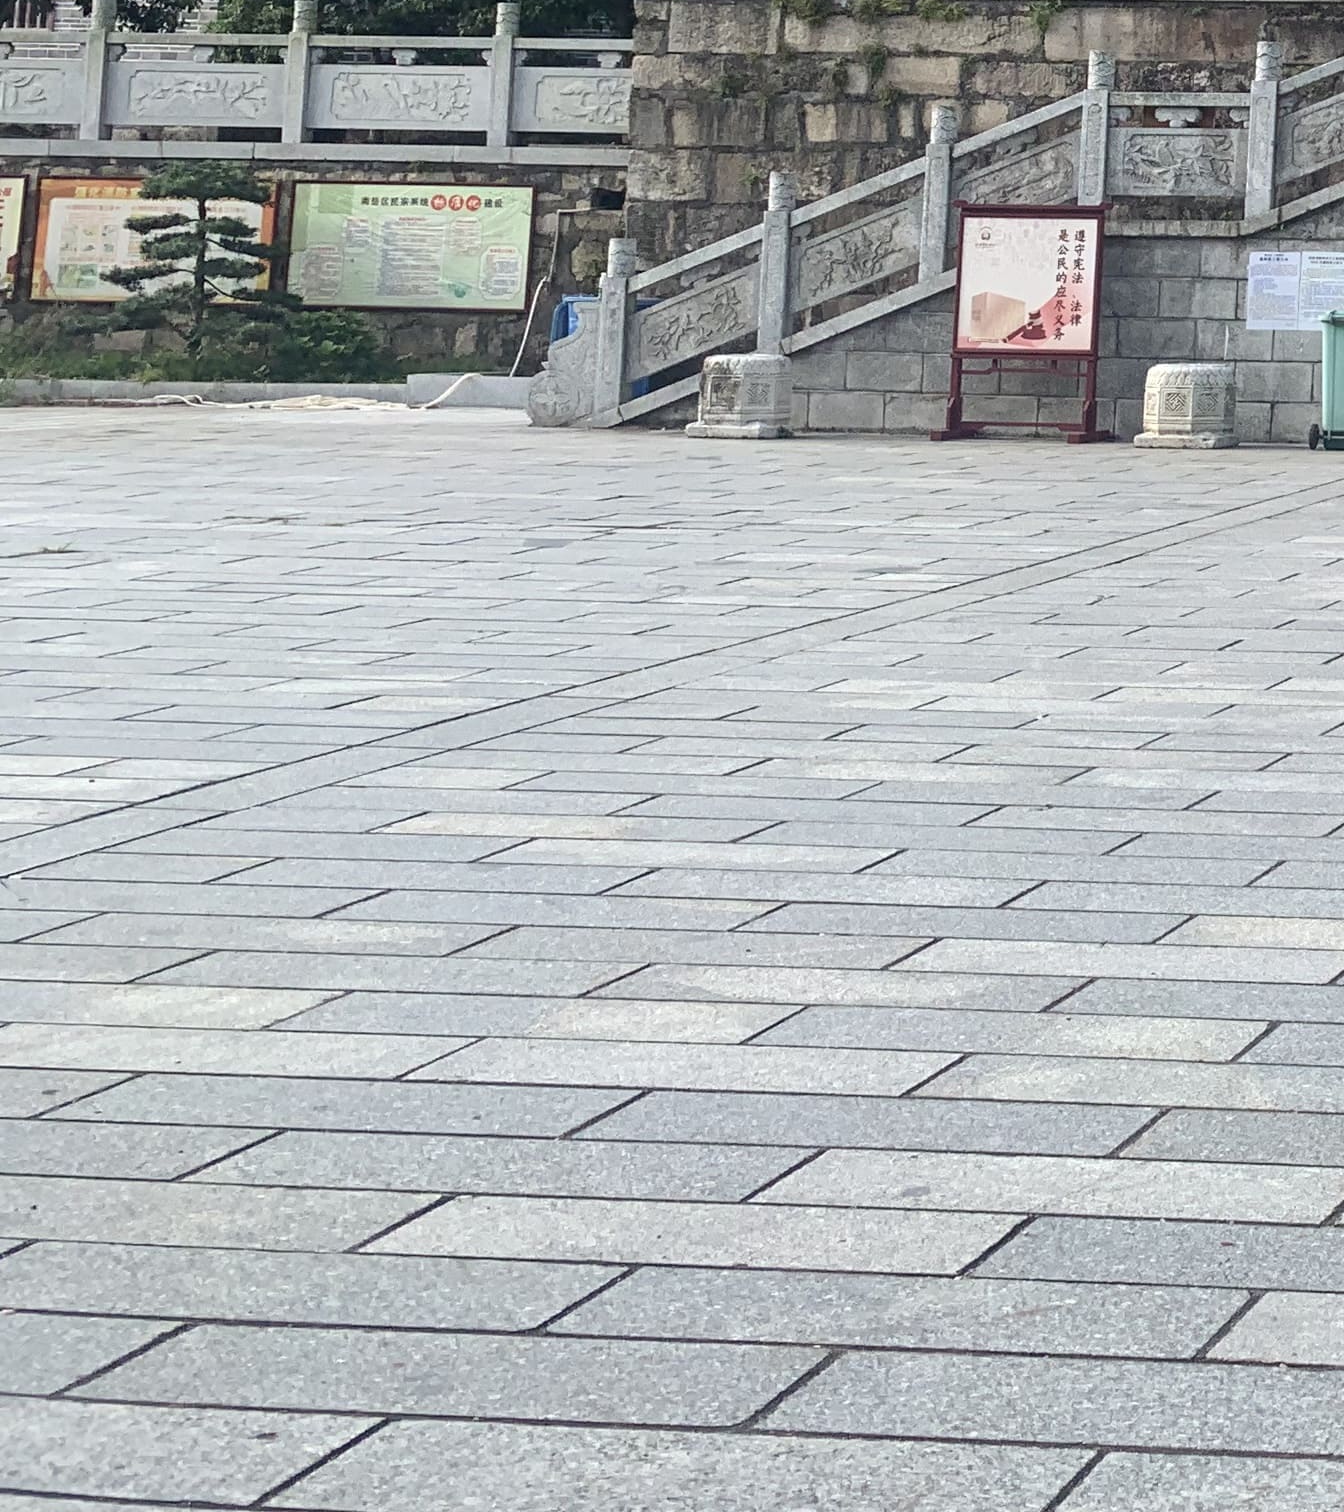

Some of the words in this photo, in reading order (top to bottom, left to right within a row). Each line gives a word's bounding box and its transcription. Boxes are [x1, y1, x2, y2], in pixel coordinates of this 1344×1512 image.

[1053, 229, 1070, 341] 是公民的应尽义务
[1070, 229, 1086, 327] 遵守宪法、法律
